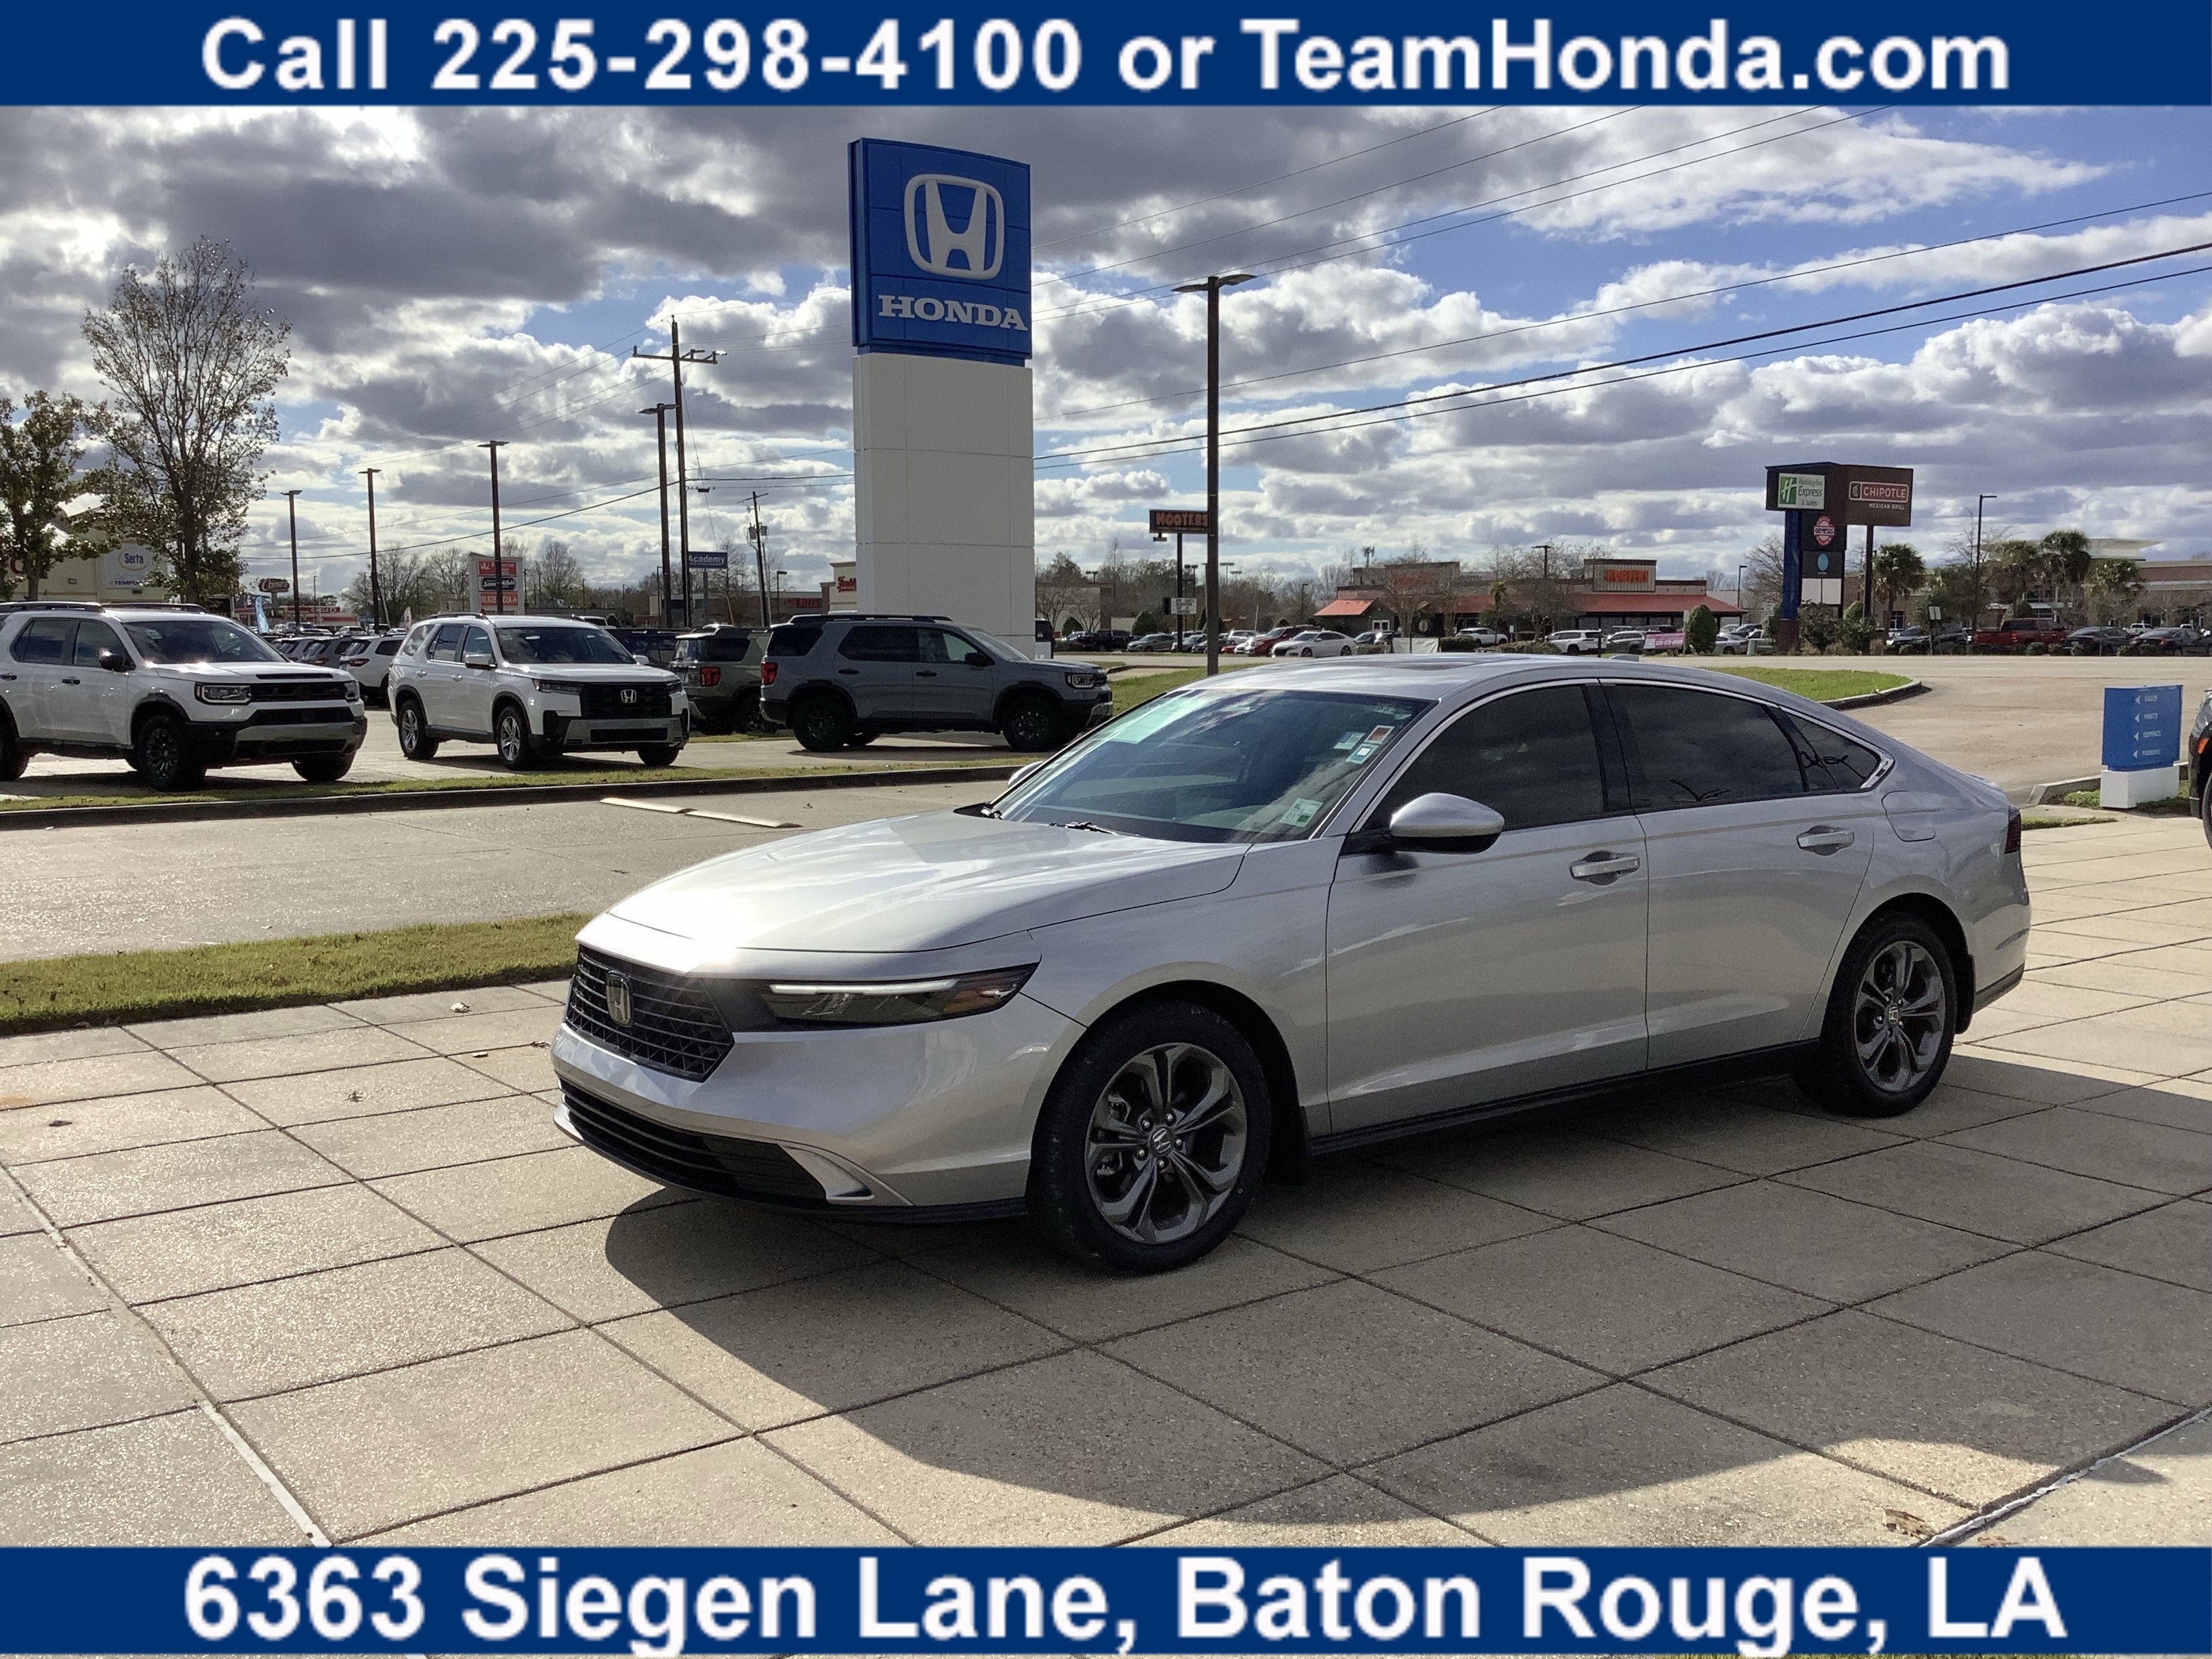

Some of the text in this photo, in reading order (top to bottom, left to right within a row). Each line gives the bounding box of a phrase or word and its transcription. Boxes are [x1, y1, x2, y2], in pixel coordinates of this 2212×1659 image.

[878, 294, 1027, 331] HONDA
[1798, 485, 1823, 499] Express
[1863, 487, 1906, 498] CHIPOTLE
[1155, 512, 1208, 527] HOOTERS
[124, 552, 144, 564] Serta
[689, 554, 725, 565] Academy
